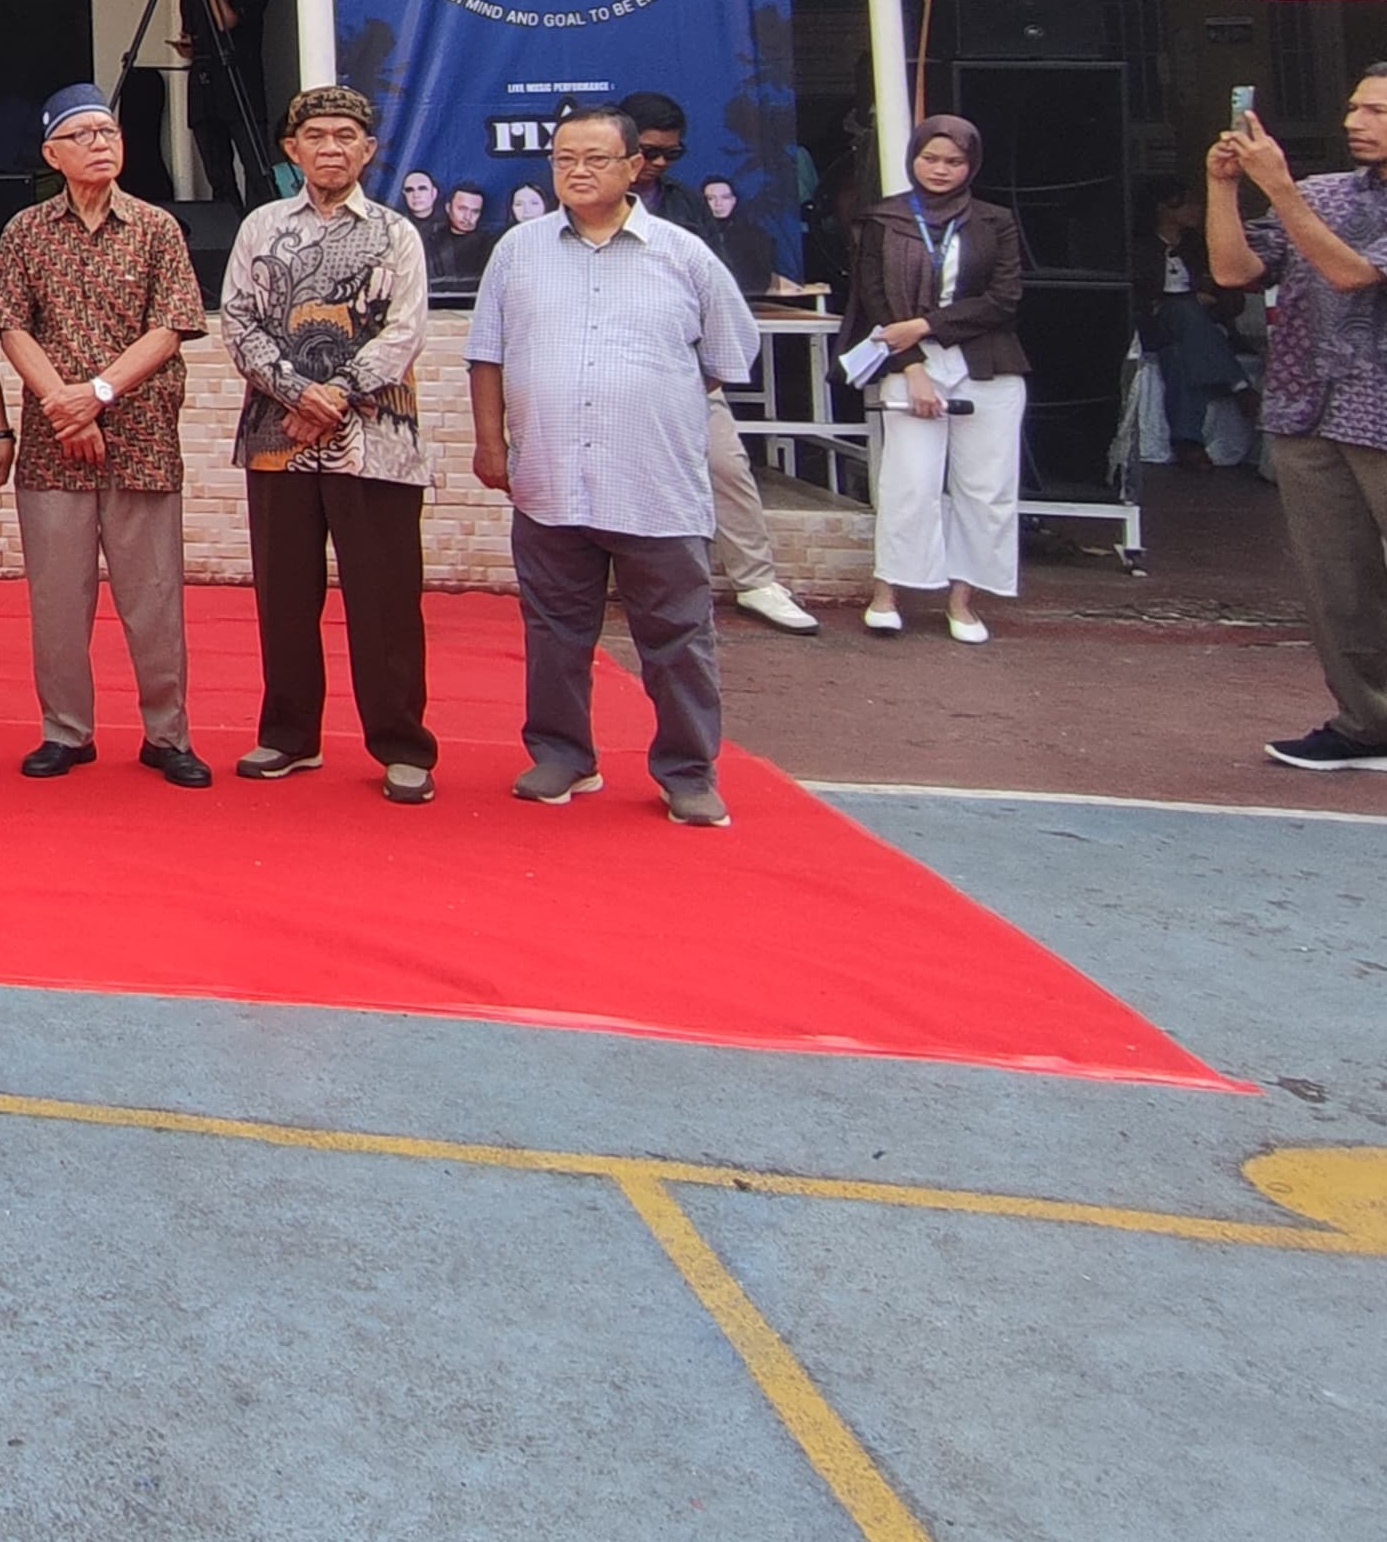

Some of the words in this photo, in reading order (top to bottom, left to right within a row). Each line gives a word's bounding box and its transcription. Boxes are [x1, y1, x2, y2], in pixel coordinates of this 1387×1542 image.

[505, 8, 540, 27] AND
[543, 10, 587, 27] GOAL
[588, 6, 610, 23] TO
